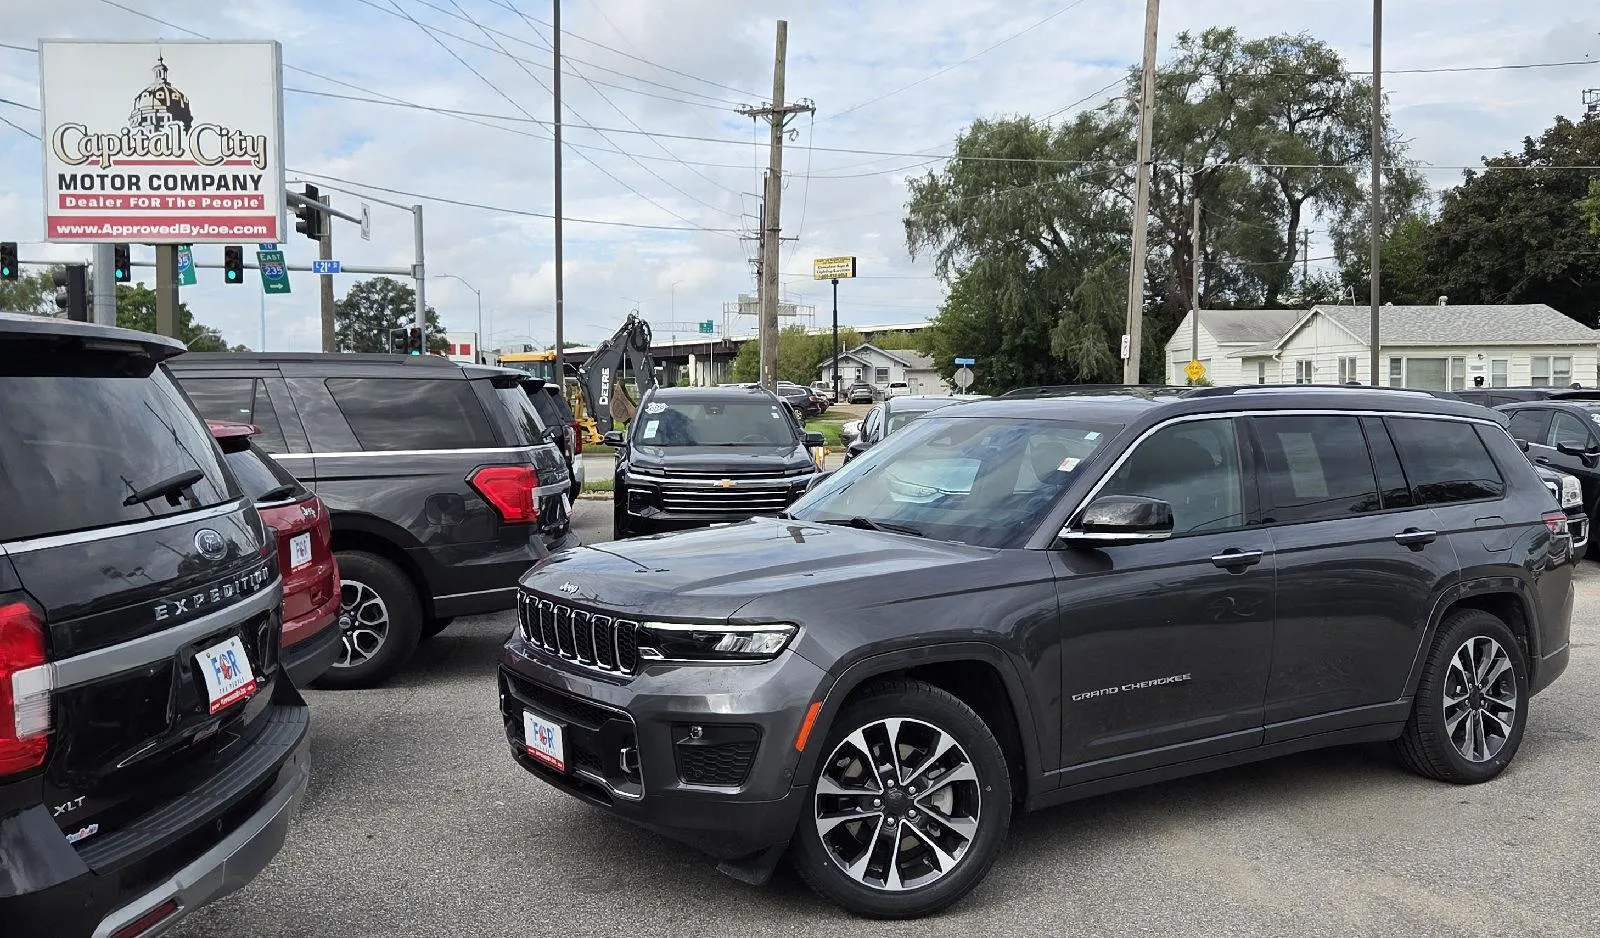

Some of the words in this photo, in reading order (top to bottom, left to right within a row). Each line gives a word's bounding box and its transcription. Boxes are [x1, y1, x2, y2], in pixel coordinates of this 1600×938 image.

[52, 122, 185, 169] Capital
[189, 122, 267, 170] City
[58, 173, 141, 191] MOTOR
[148, 174, 263, 191] COMPANY
[65, 196, 123, 208] Dealer
[129, 197, 161, 208] FOR
[165, 197, 196, 208] The
[56, 223, 267, 236] www.ApprovedByJoe.com
[178, 257, 189, 267] 35
[260, 253, 281, 262] EAST
[265, 266, 283, 275] 235
[599, 367, 610, 405] DEERE
[154, 566, 270, 622] EXPEDITION
[559, 581, 580, 595] Jeep
[1071, 687, 1119, 702] GRAND
[1121, 672, 1192, 692] CHEROKEE
[53, 795, 86, 817] XLT
